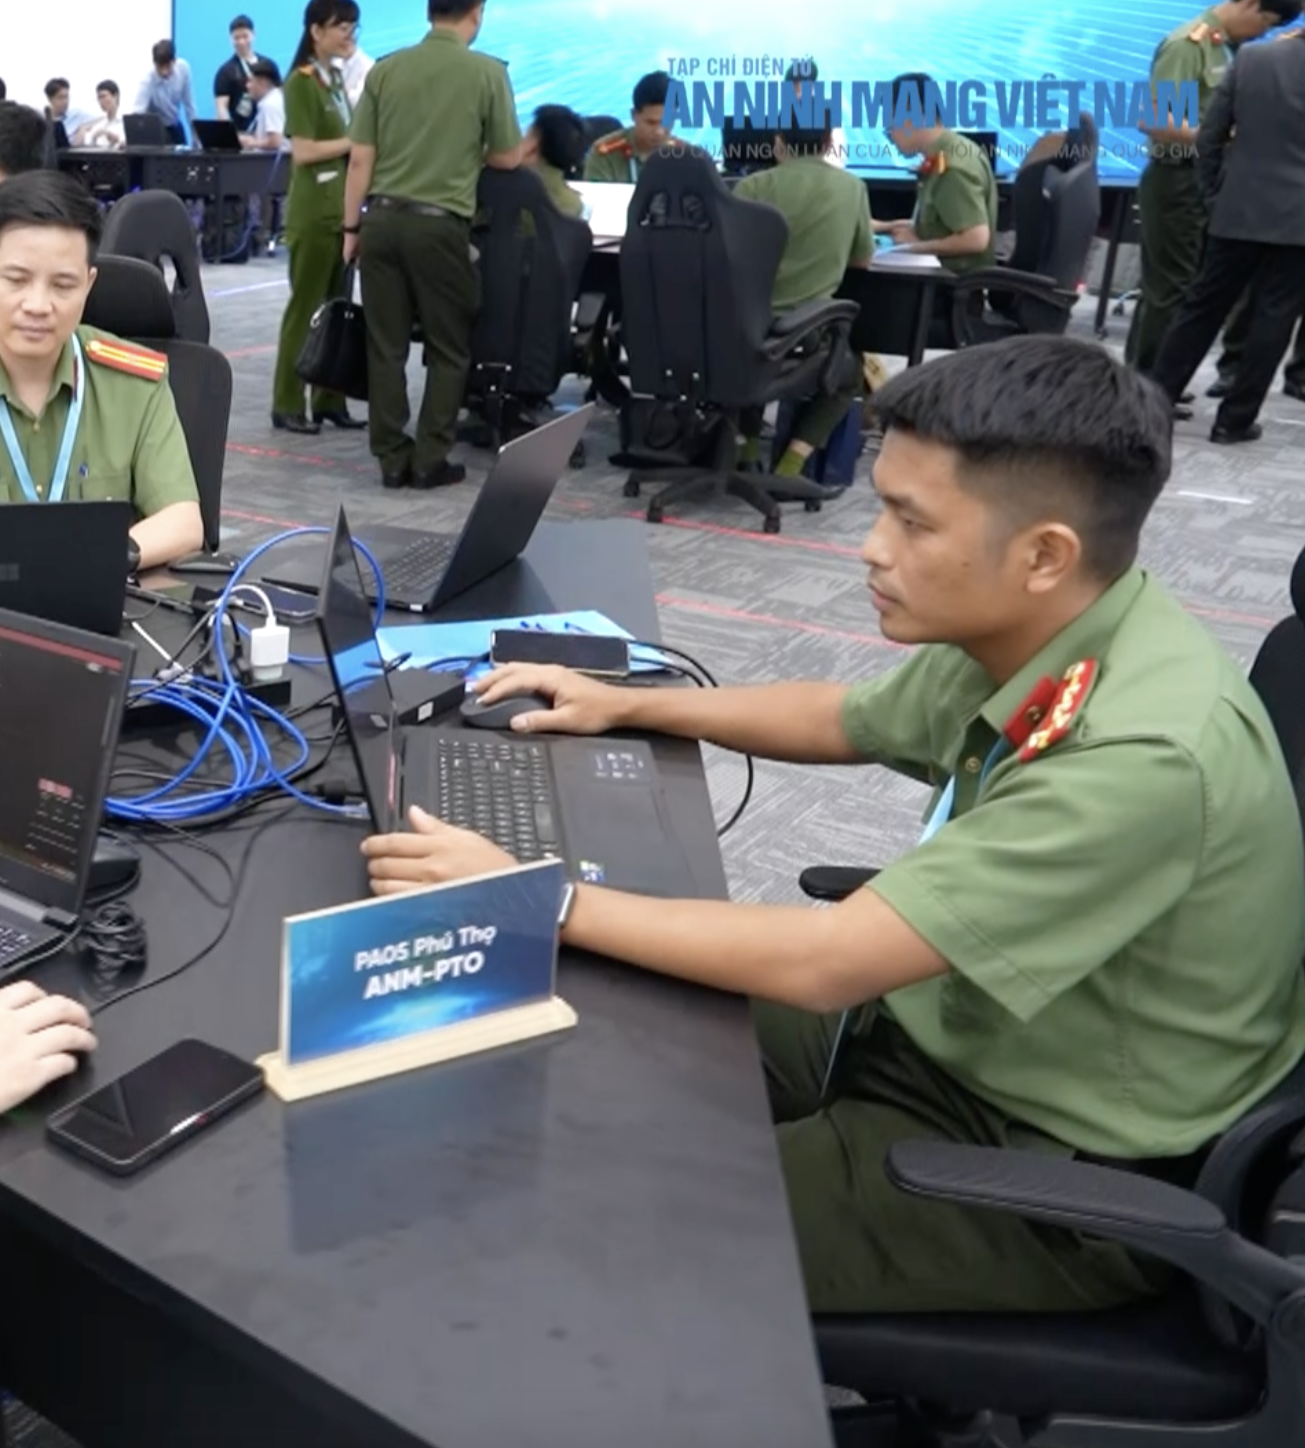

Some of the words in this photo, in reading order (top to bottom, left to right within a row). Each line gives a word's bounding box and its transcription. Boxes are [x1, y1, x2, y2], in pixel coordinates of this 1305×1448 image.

[413, 931, 453, 956] Phú
[458, 926, 497, 945] Thọ
[364, 952, 484, 999] ANM-PTO
